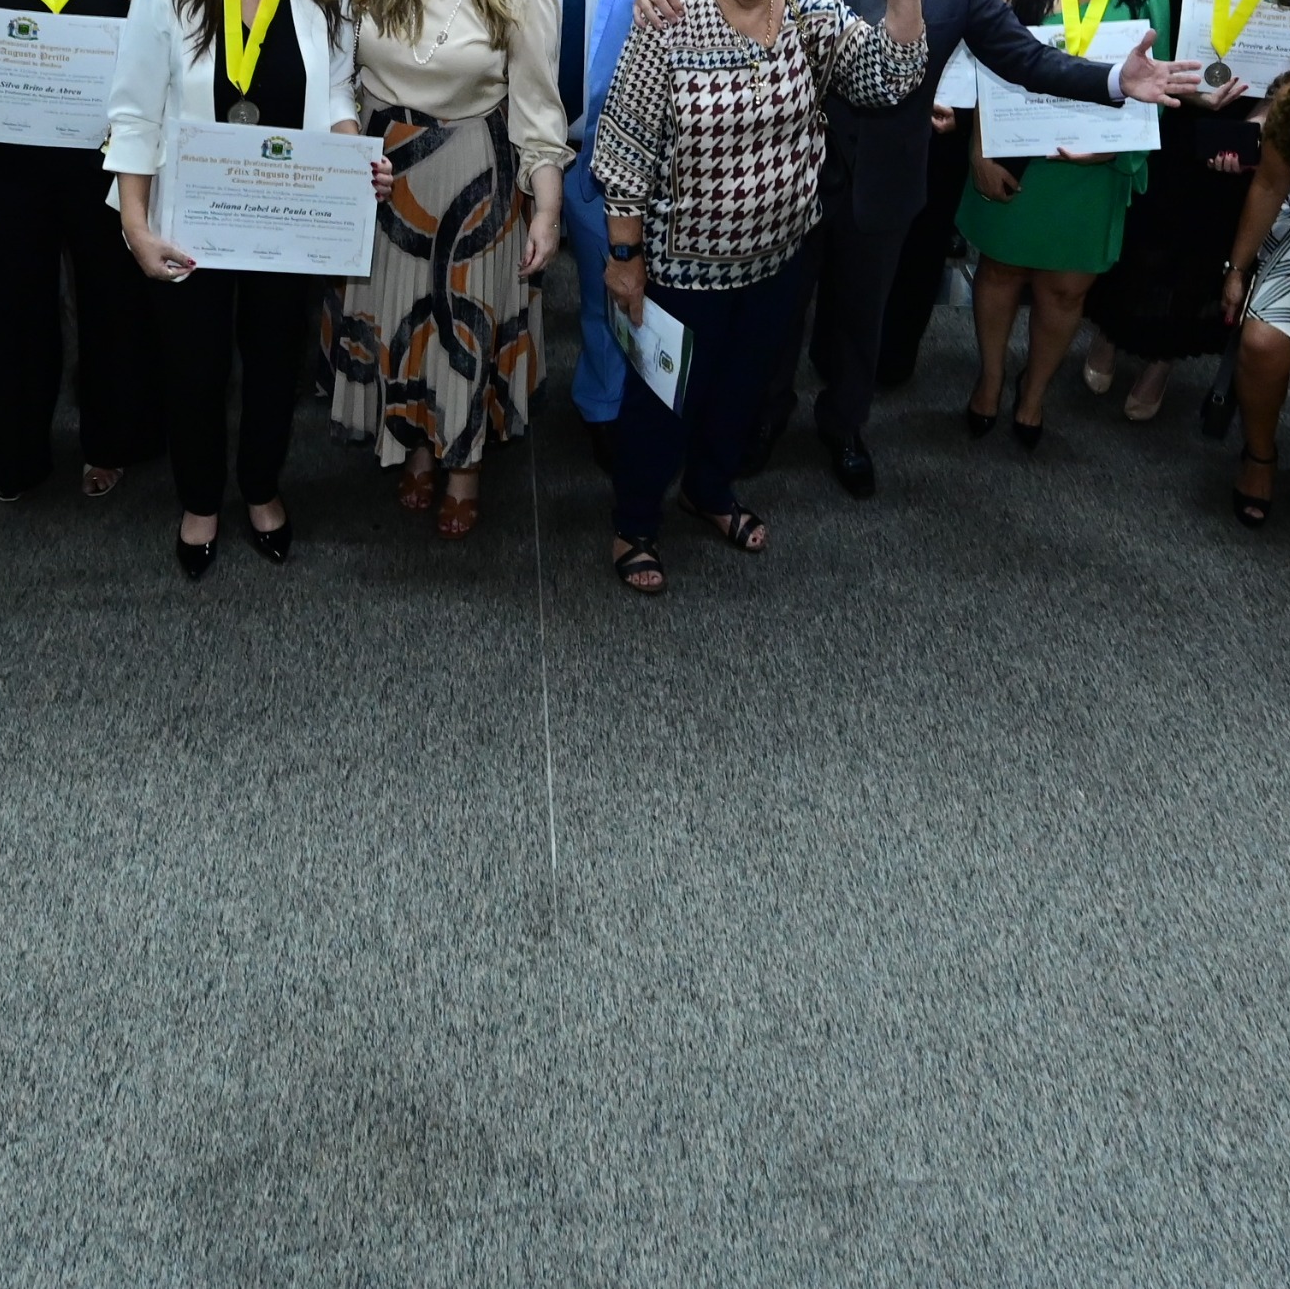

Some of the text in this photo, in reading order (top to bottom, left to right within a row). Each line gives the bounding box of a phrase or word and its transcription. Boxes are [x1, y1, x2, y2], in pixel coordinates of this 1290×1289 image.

[0, 46, 36, 58] Augusto
[40, 51, 70, 62] Perillo
[0, 81, 20, 90] Silva
[23, 83, 43, 92] Brito
[57, 87, 82, 96] Abreu
[225, 168, 323, 182] Félix Augusto Perillo
[209, 201, 332, 217] Juliana Izabel de Paula Costa
